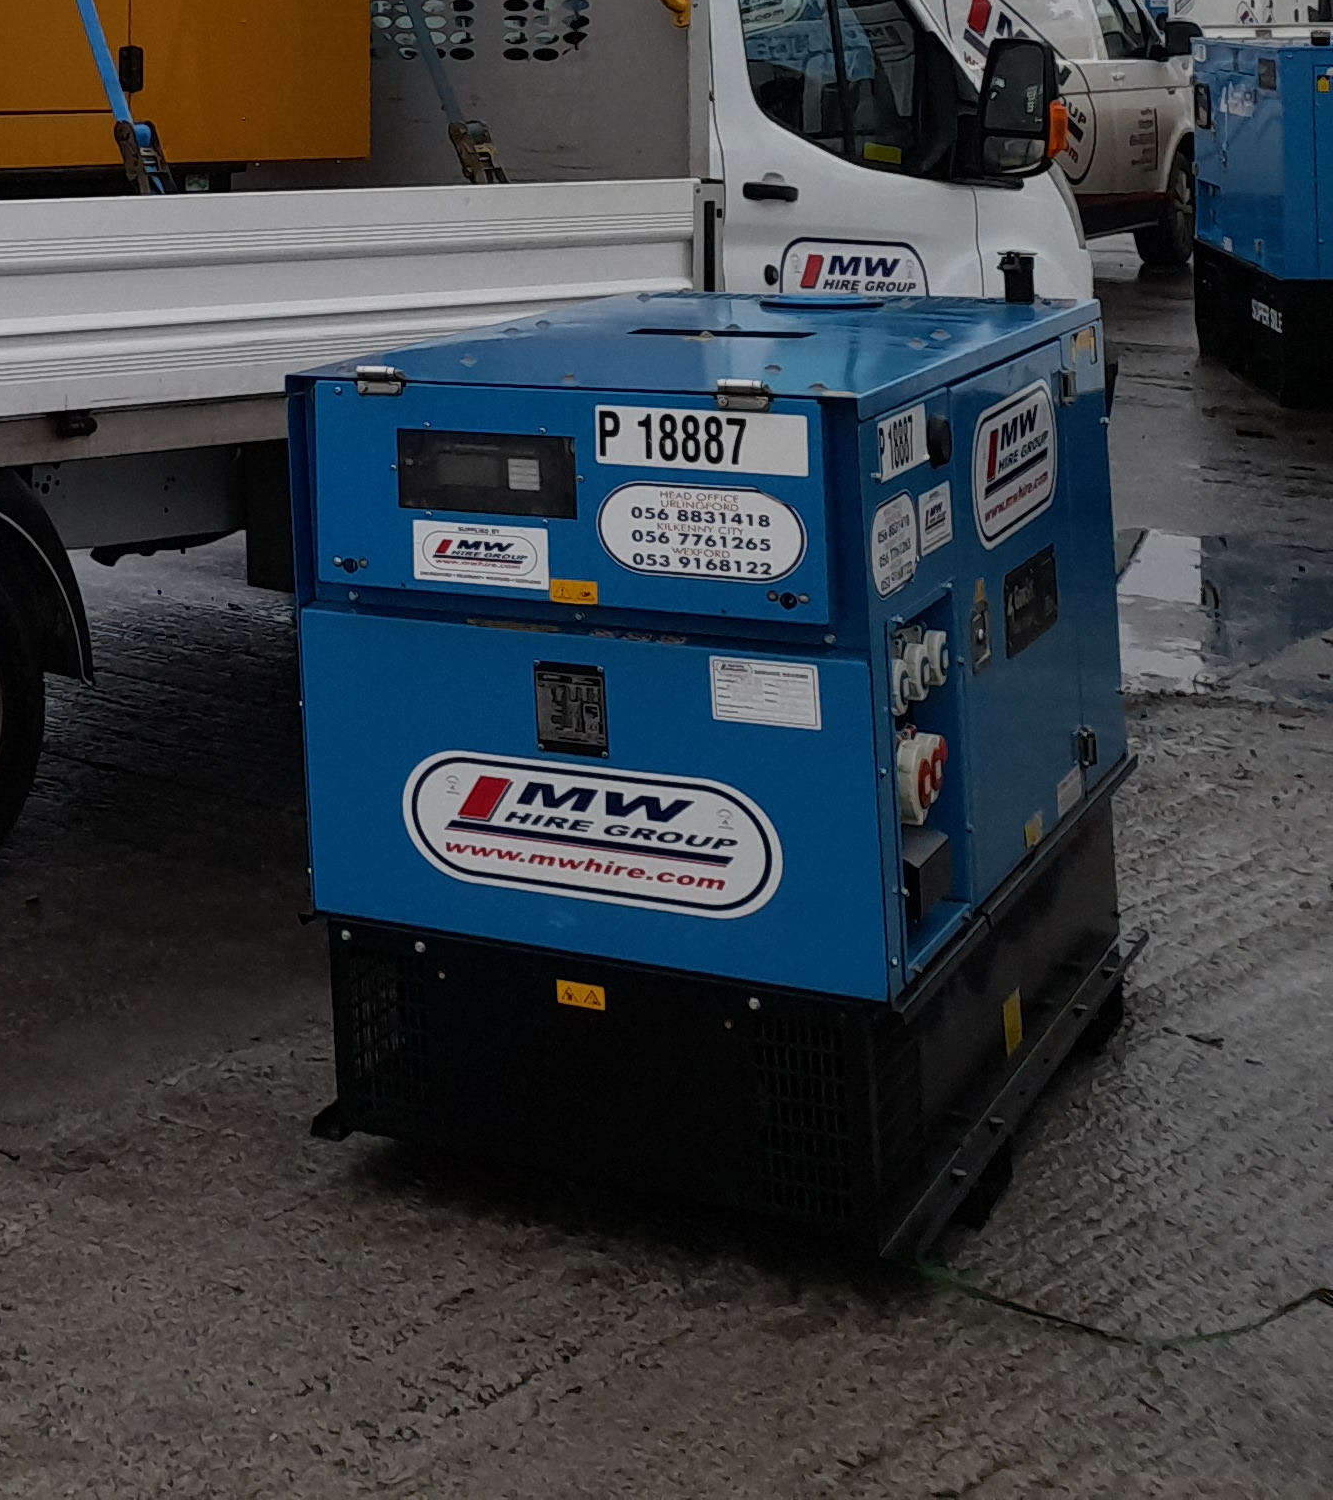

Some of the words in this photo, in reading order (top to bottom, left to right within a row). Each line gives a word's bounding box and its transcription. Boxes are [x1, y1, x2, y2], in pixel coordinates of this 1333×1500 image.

[827, 255, 902, 278] MW
[822, 279, 862, 291] HIRE
[864, 280, 917, 293] GROUP
[598, 410, 621, 457] P
[637, 413, 748, 466] 18887
[1000, 403, 1039, 452] MW
[997, 448, 1019, 474] HIRE
[659, 490, 693, 501] HEAD
[695, 492, 739, 504] OFFICE
[631, 506, 670, 521] 056
[677, 509, 771, 528] 8831418
[631, 529, 670, 545] 056
[678, 532, 772, 552] 7761265
[656, 522, 714, 534] KILKENNY
[718, 525, 744, 536] CITY
[456, 539, 515, 553] MW
[671, 546, 731, 559] WEXFORD
[632, 552, 671, 567] 053
[678, 556, 773, 576] 9168122
[515, 781, 696, 824] MW
[503, 810, 595, 833] HIRE
[603, 823, 739, 851] GROUP
[443, 840, 727, 892] www.mwhire.com
